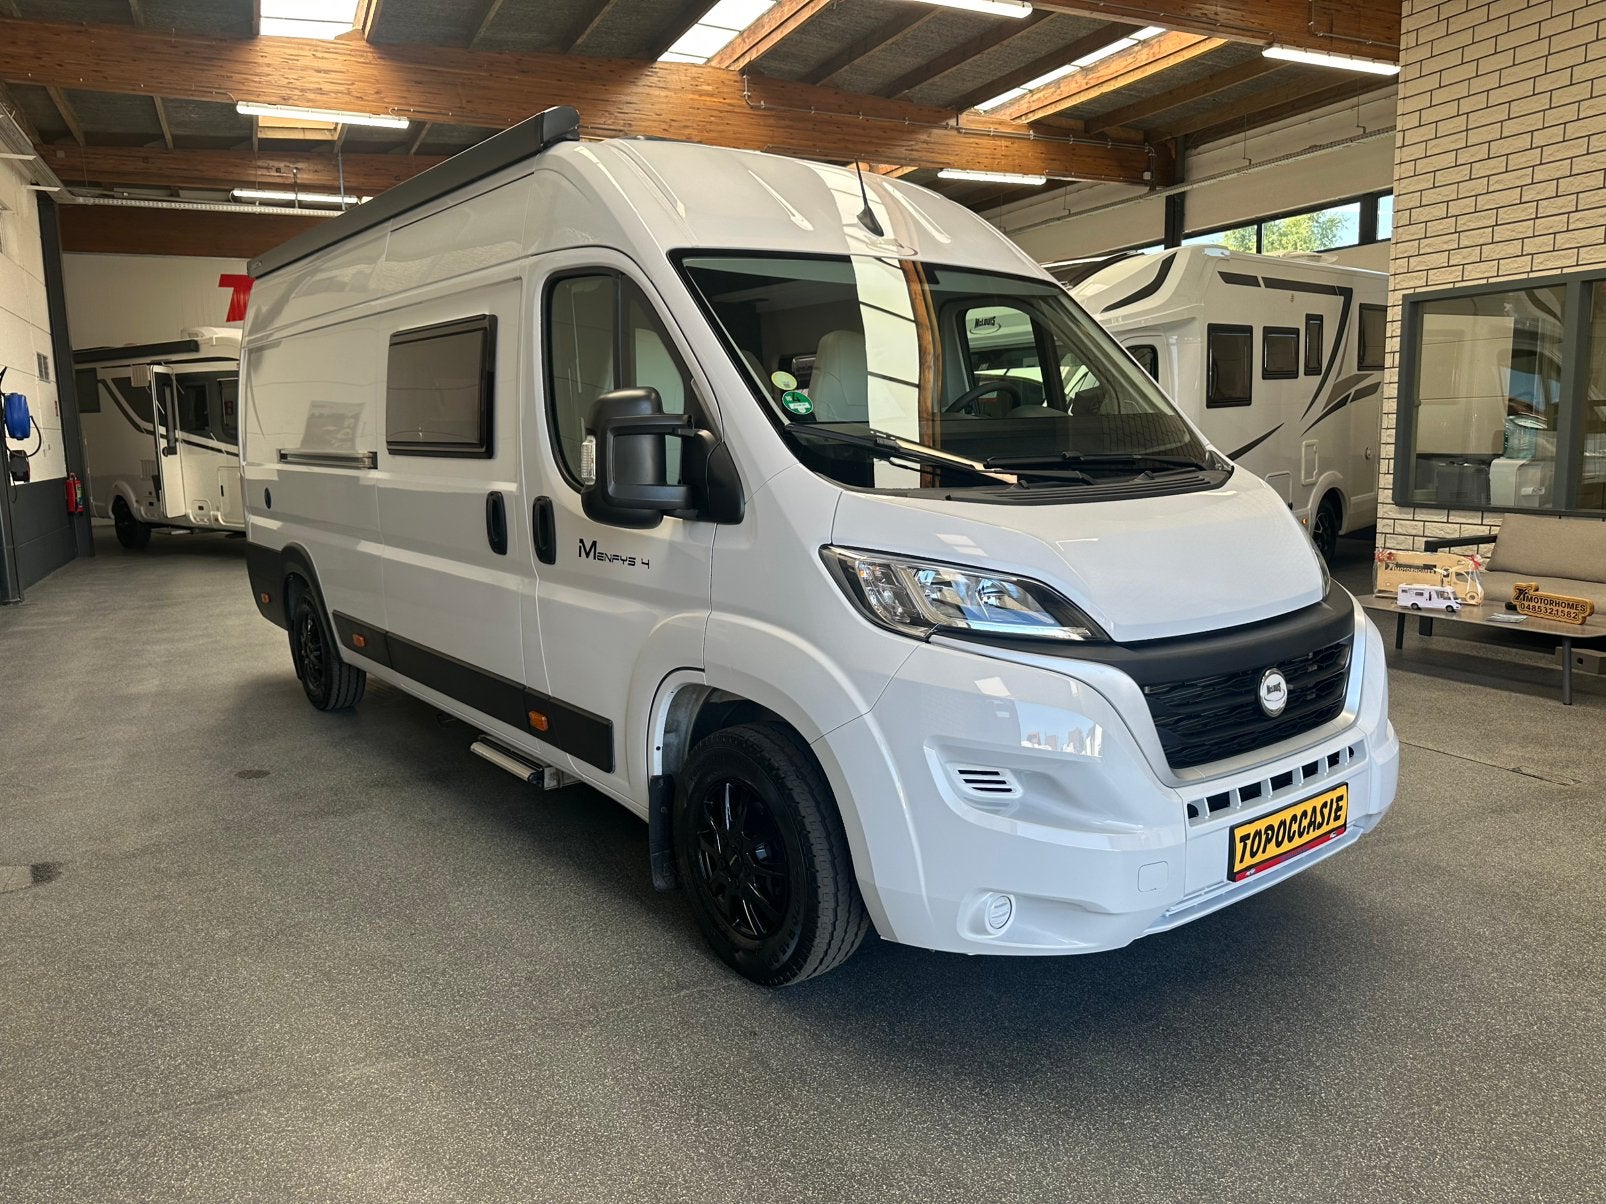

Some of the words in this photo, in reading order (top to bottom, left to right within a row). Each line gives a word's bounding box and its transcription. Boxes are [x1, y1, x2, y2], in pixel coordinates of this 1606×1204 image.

[641, 557, 650, 569] 4
[1520, 602, 1578, 619] 0485321582
[1525, 595, 1586, 612] MOTORHOMES
[1239, 794, 1344, 864] TOPOCCASIE
